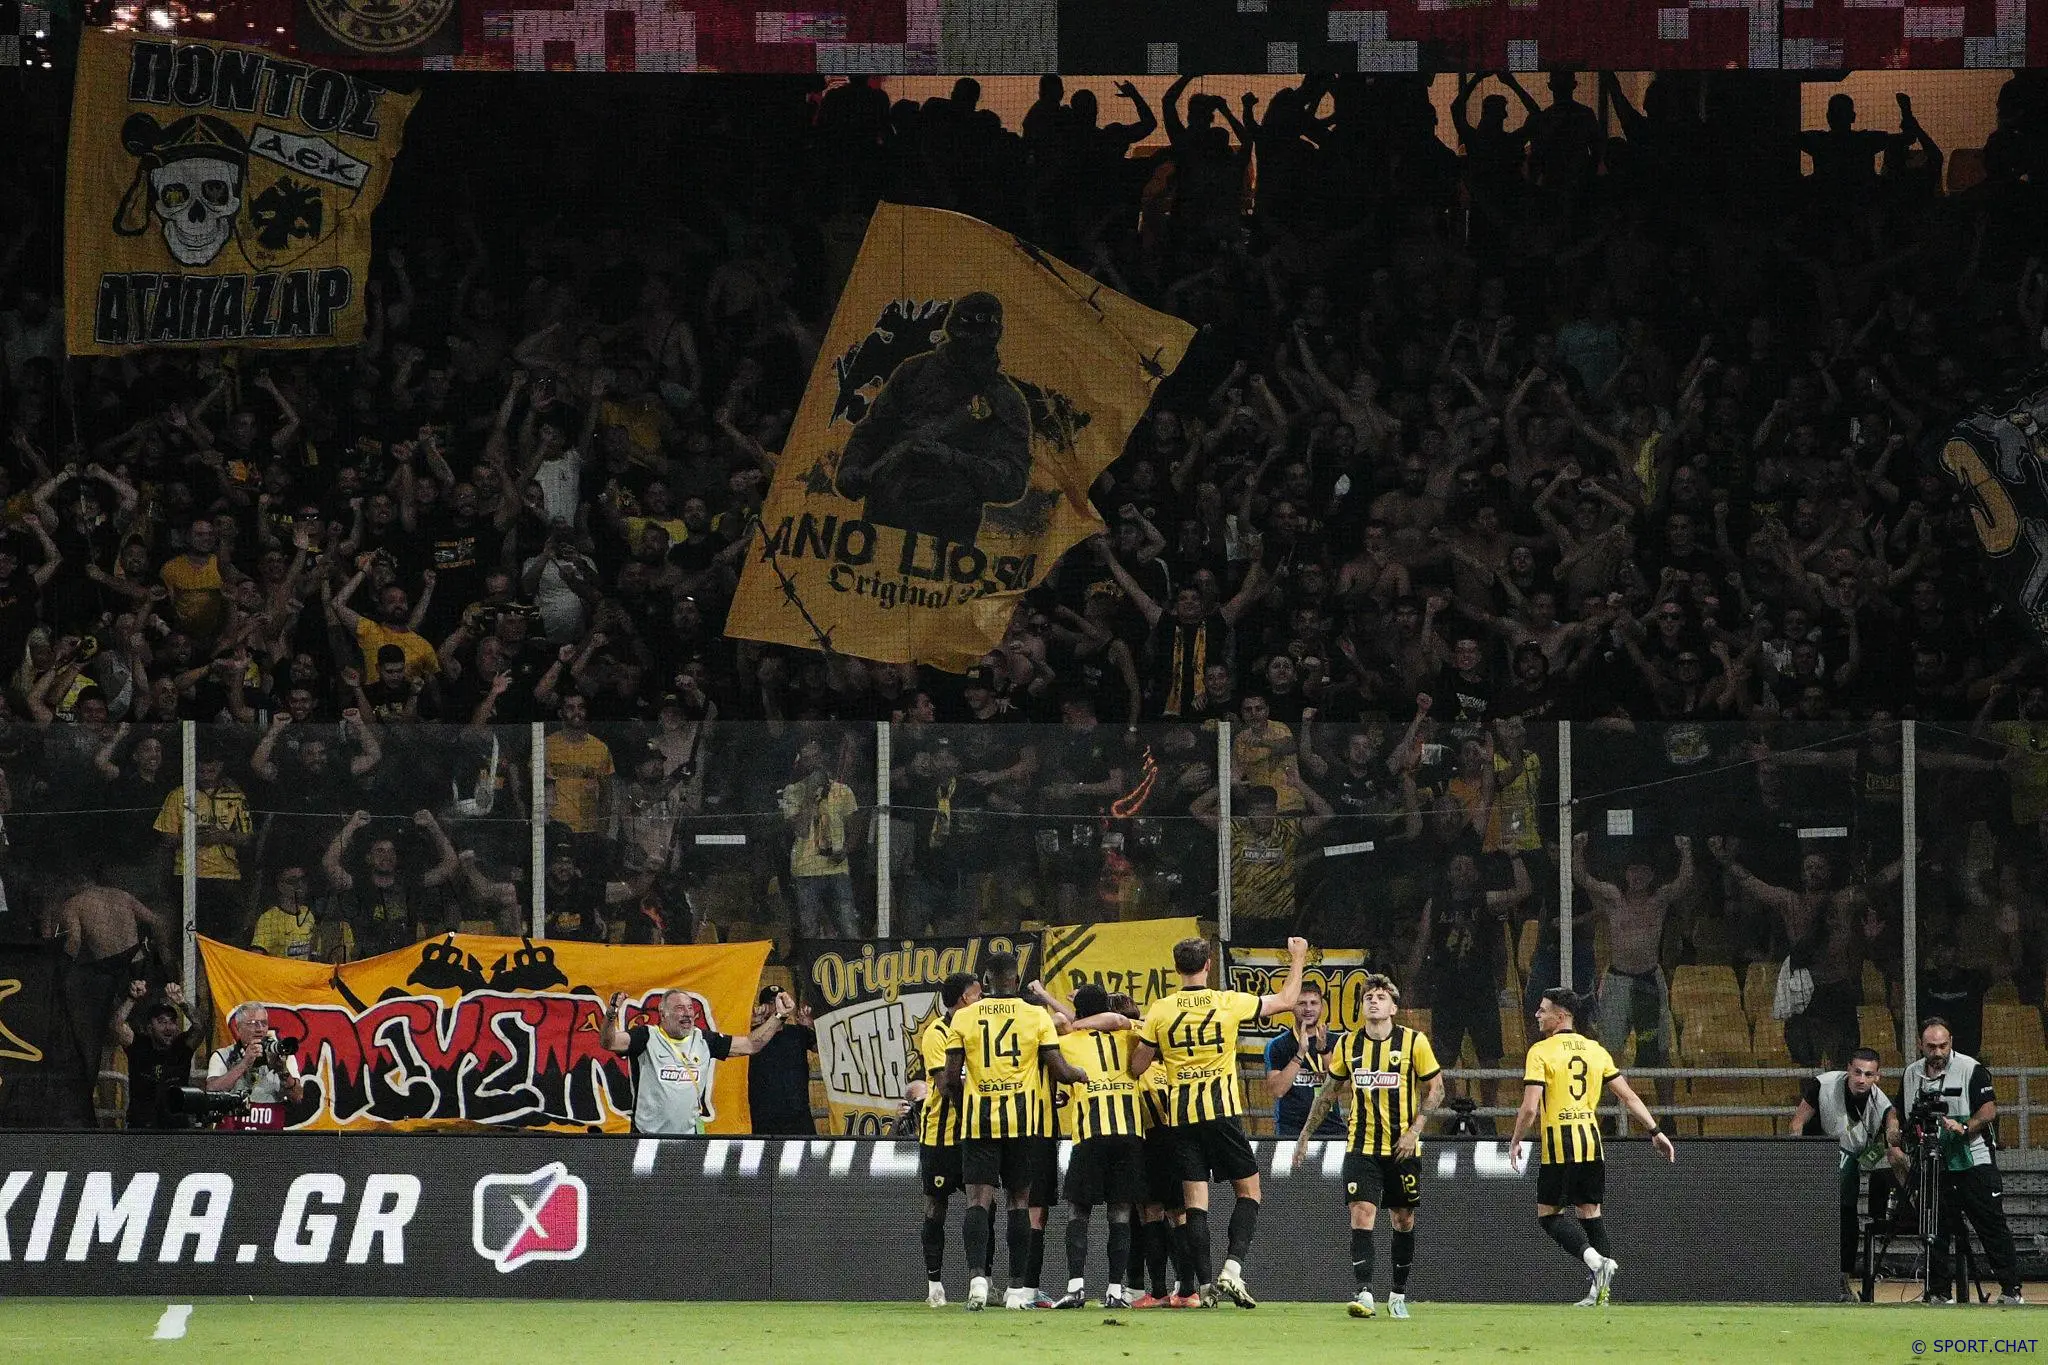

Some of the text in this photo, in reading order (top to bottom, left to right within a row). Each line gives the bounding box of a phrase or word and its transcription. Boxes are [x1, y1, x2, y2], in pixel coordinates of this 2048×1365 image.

[828, 563, 954, 609] Original
[812, 939, 981, 1006] Original
[979, 1004, 1016, 1015] PIERROT
[978, 1019, 1021, 1067] 14
[1088, 1031, 1120, 1071] 11
[1167, 1009, 1225, 1056] 44
[978, 1082, 1023, 1092] SEAJETS
[1087, 1082, 1134, 1092] SEAJETS
[1177, 1068, 1224, 1080] SEAJETS
[1568, 1056, 1588, 1100] 3
[1400, 1174, 1417, 1193] 12
